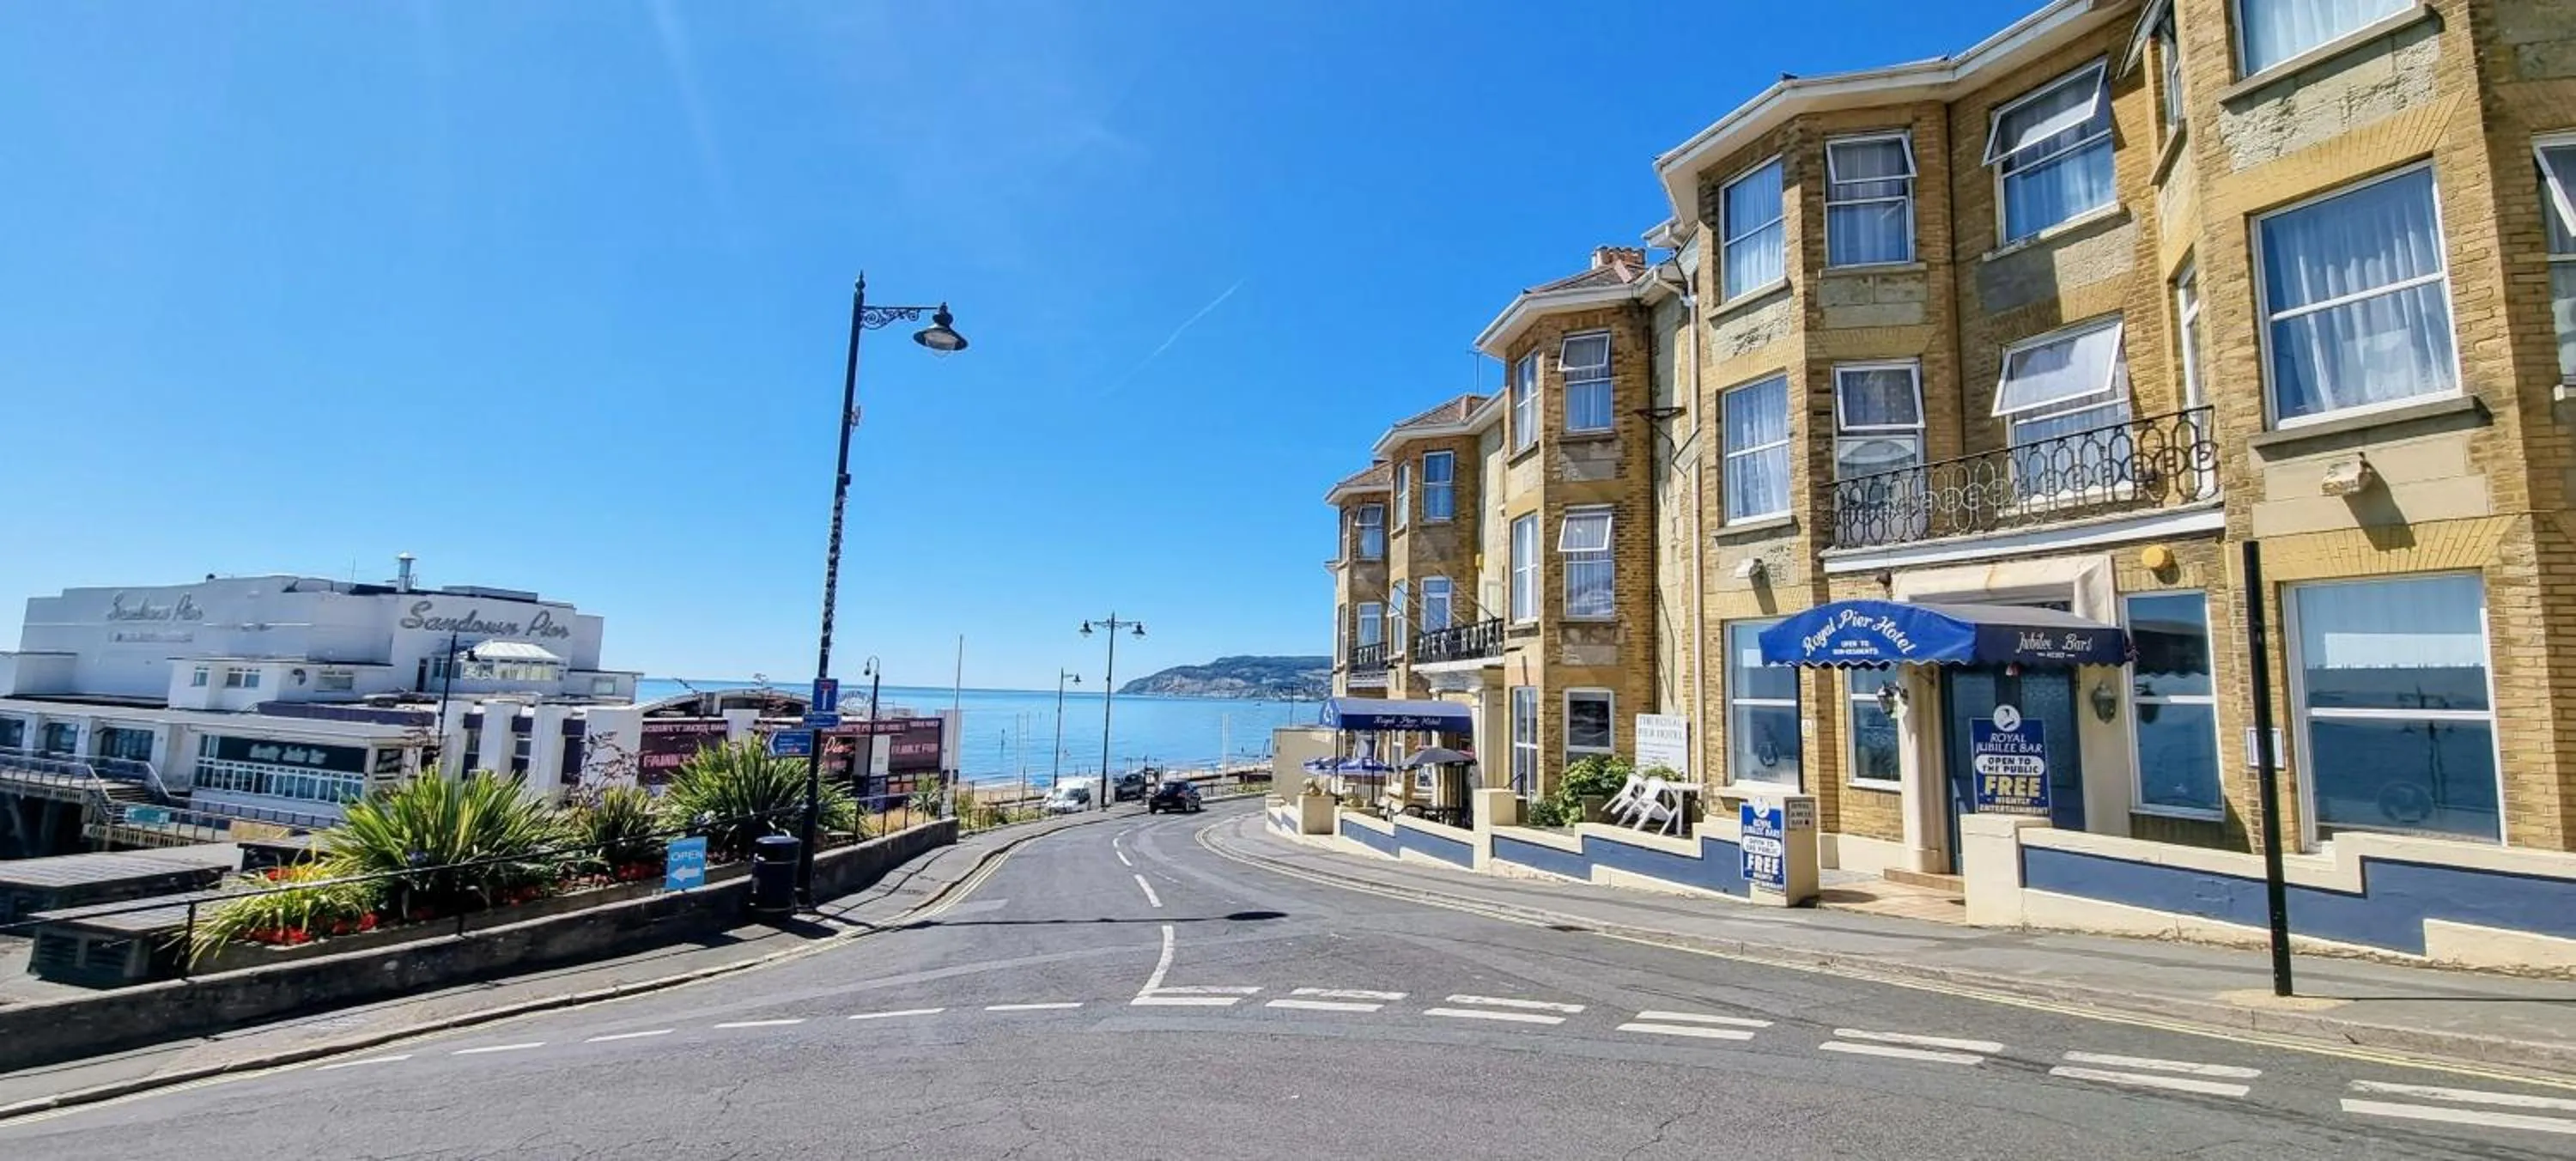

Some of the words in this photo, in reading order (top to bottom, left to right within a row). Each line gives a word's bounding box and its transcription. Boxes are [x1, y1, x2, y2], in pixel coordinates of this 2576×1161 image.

[399, 600, 519, 635] Sandown
[525, 609, 570, 639] Pier
[1802, 616, 1837, 657] Royal
[1838, 609, 1874, 629] Pier
[1871, 615, 1917, 654] Hotel
[2015, 631, 2053, 653] Jubilee
[2062, 633, 2093, 652] Bars
[1976, 742, 2016, 753] JUBILEE
[2019, 743, 2043, 753] BAR
[1990, 732, 2027, 743] ROYAL
[1983, 764, 2000, 773] THE
[2003, 765, 2038, 774] PUBLIC
[1988, 757, 2015, 765] OPEN
[1984, 775, 2041, 797] FREE
[1747, 853, 1781, 875] FREE
